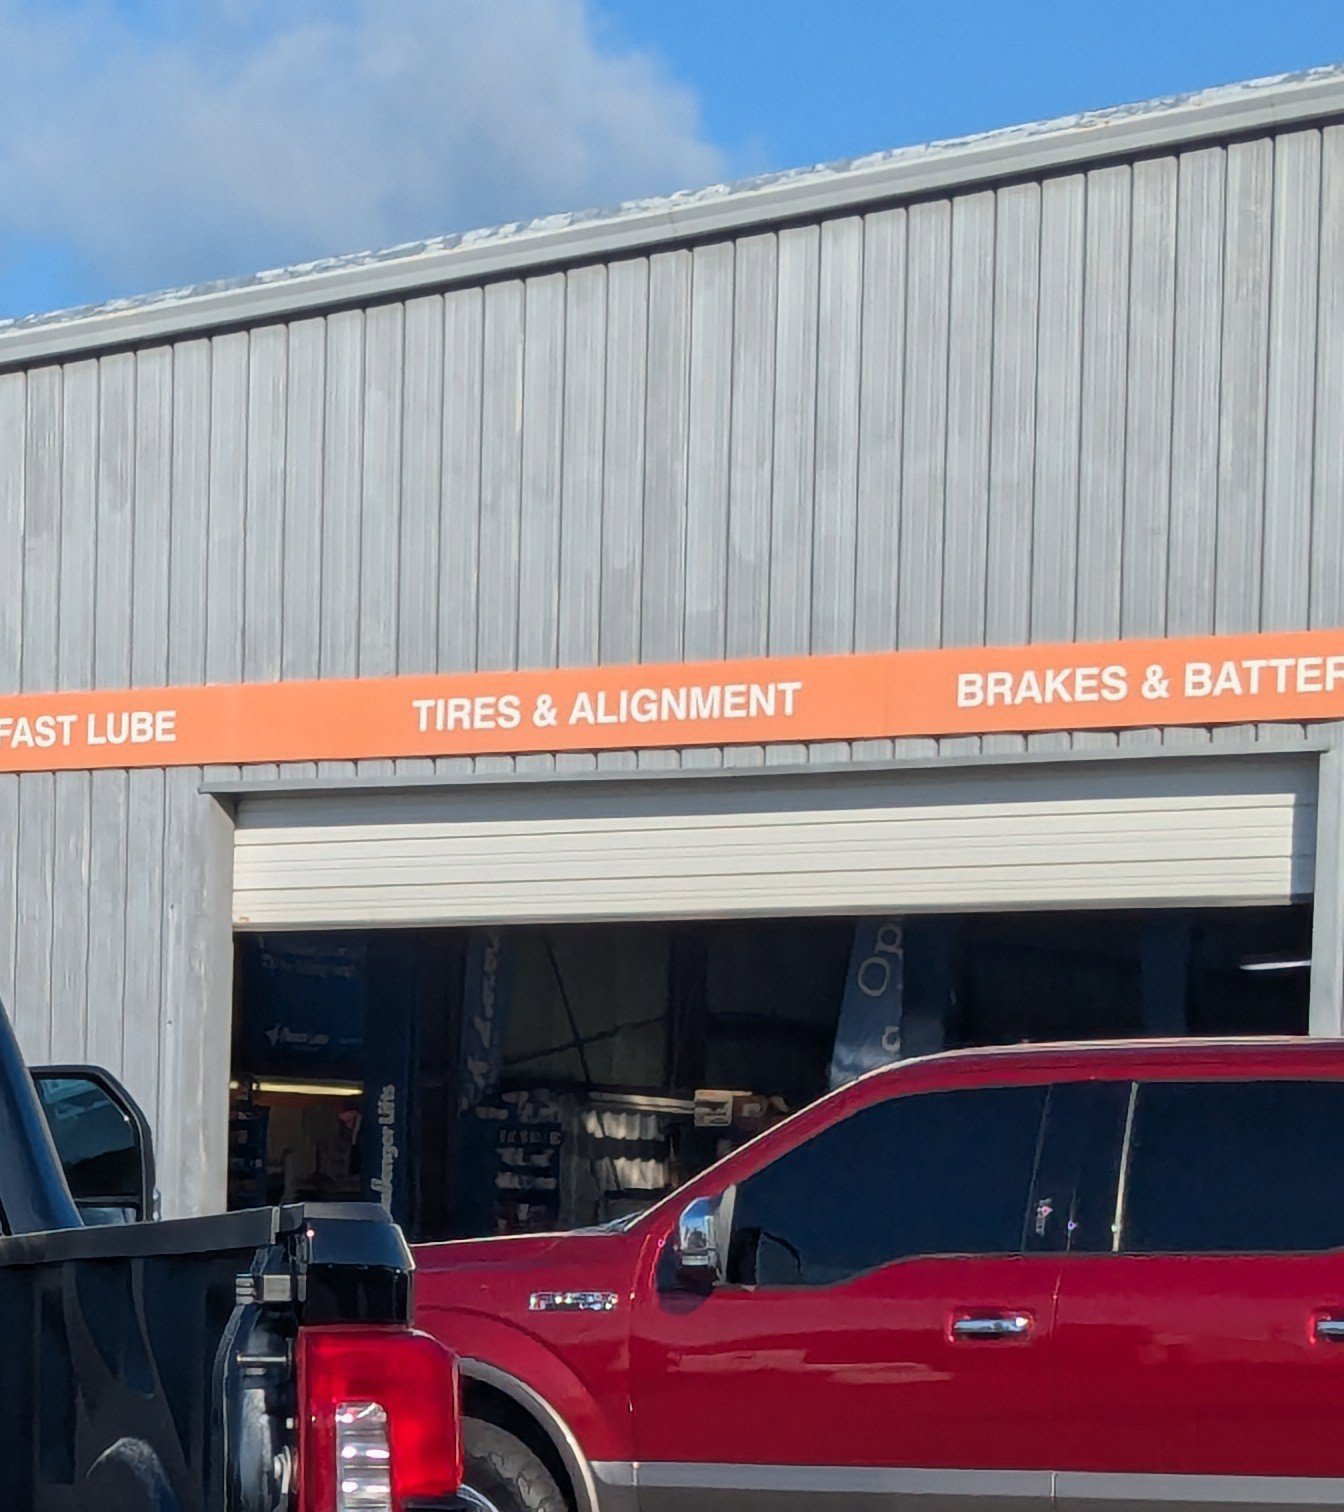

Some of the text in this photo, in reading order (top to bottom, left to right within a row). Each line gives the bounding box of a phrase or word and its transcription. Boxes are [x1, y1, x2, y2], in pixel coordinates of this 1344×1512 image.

[411, 681, 803, 732] TIRES & ALIGNMENT
[957, 665, 1128, 708] BRAKES
[1141, 664, 1171, 700] &
[87, 710, 177, 745] LUBE
